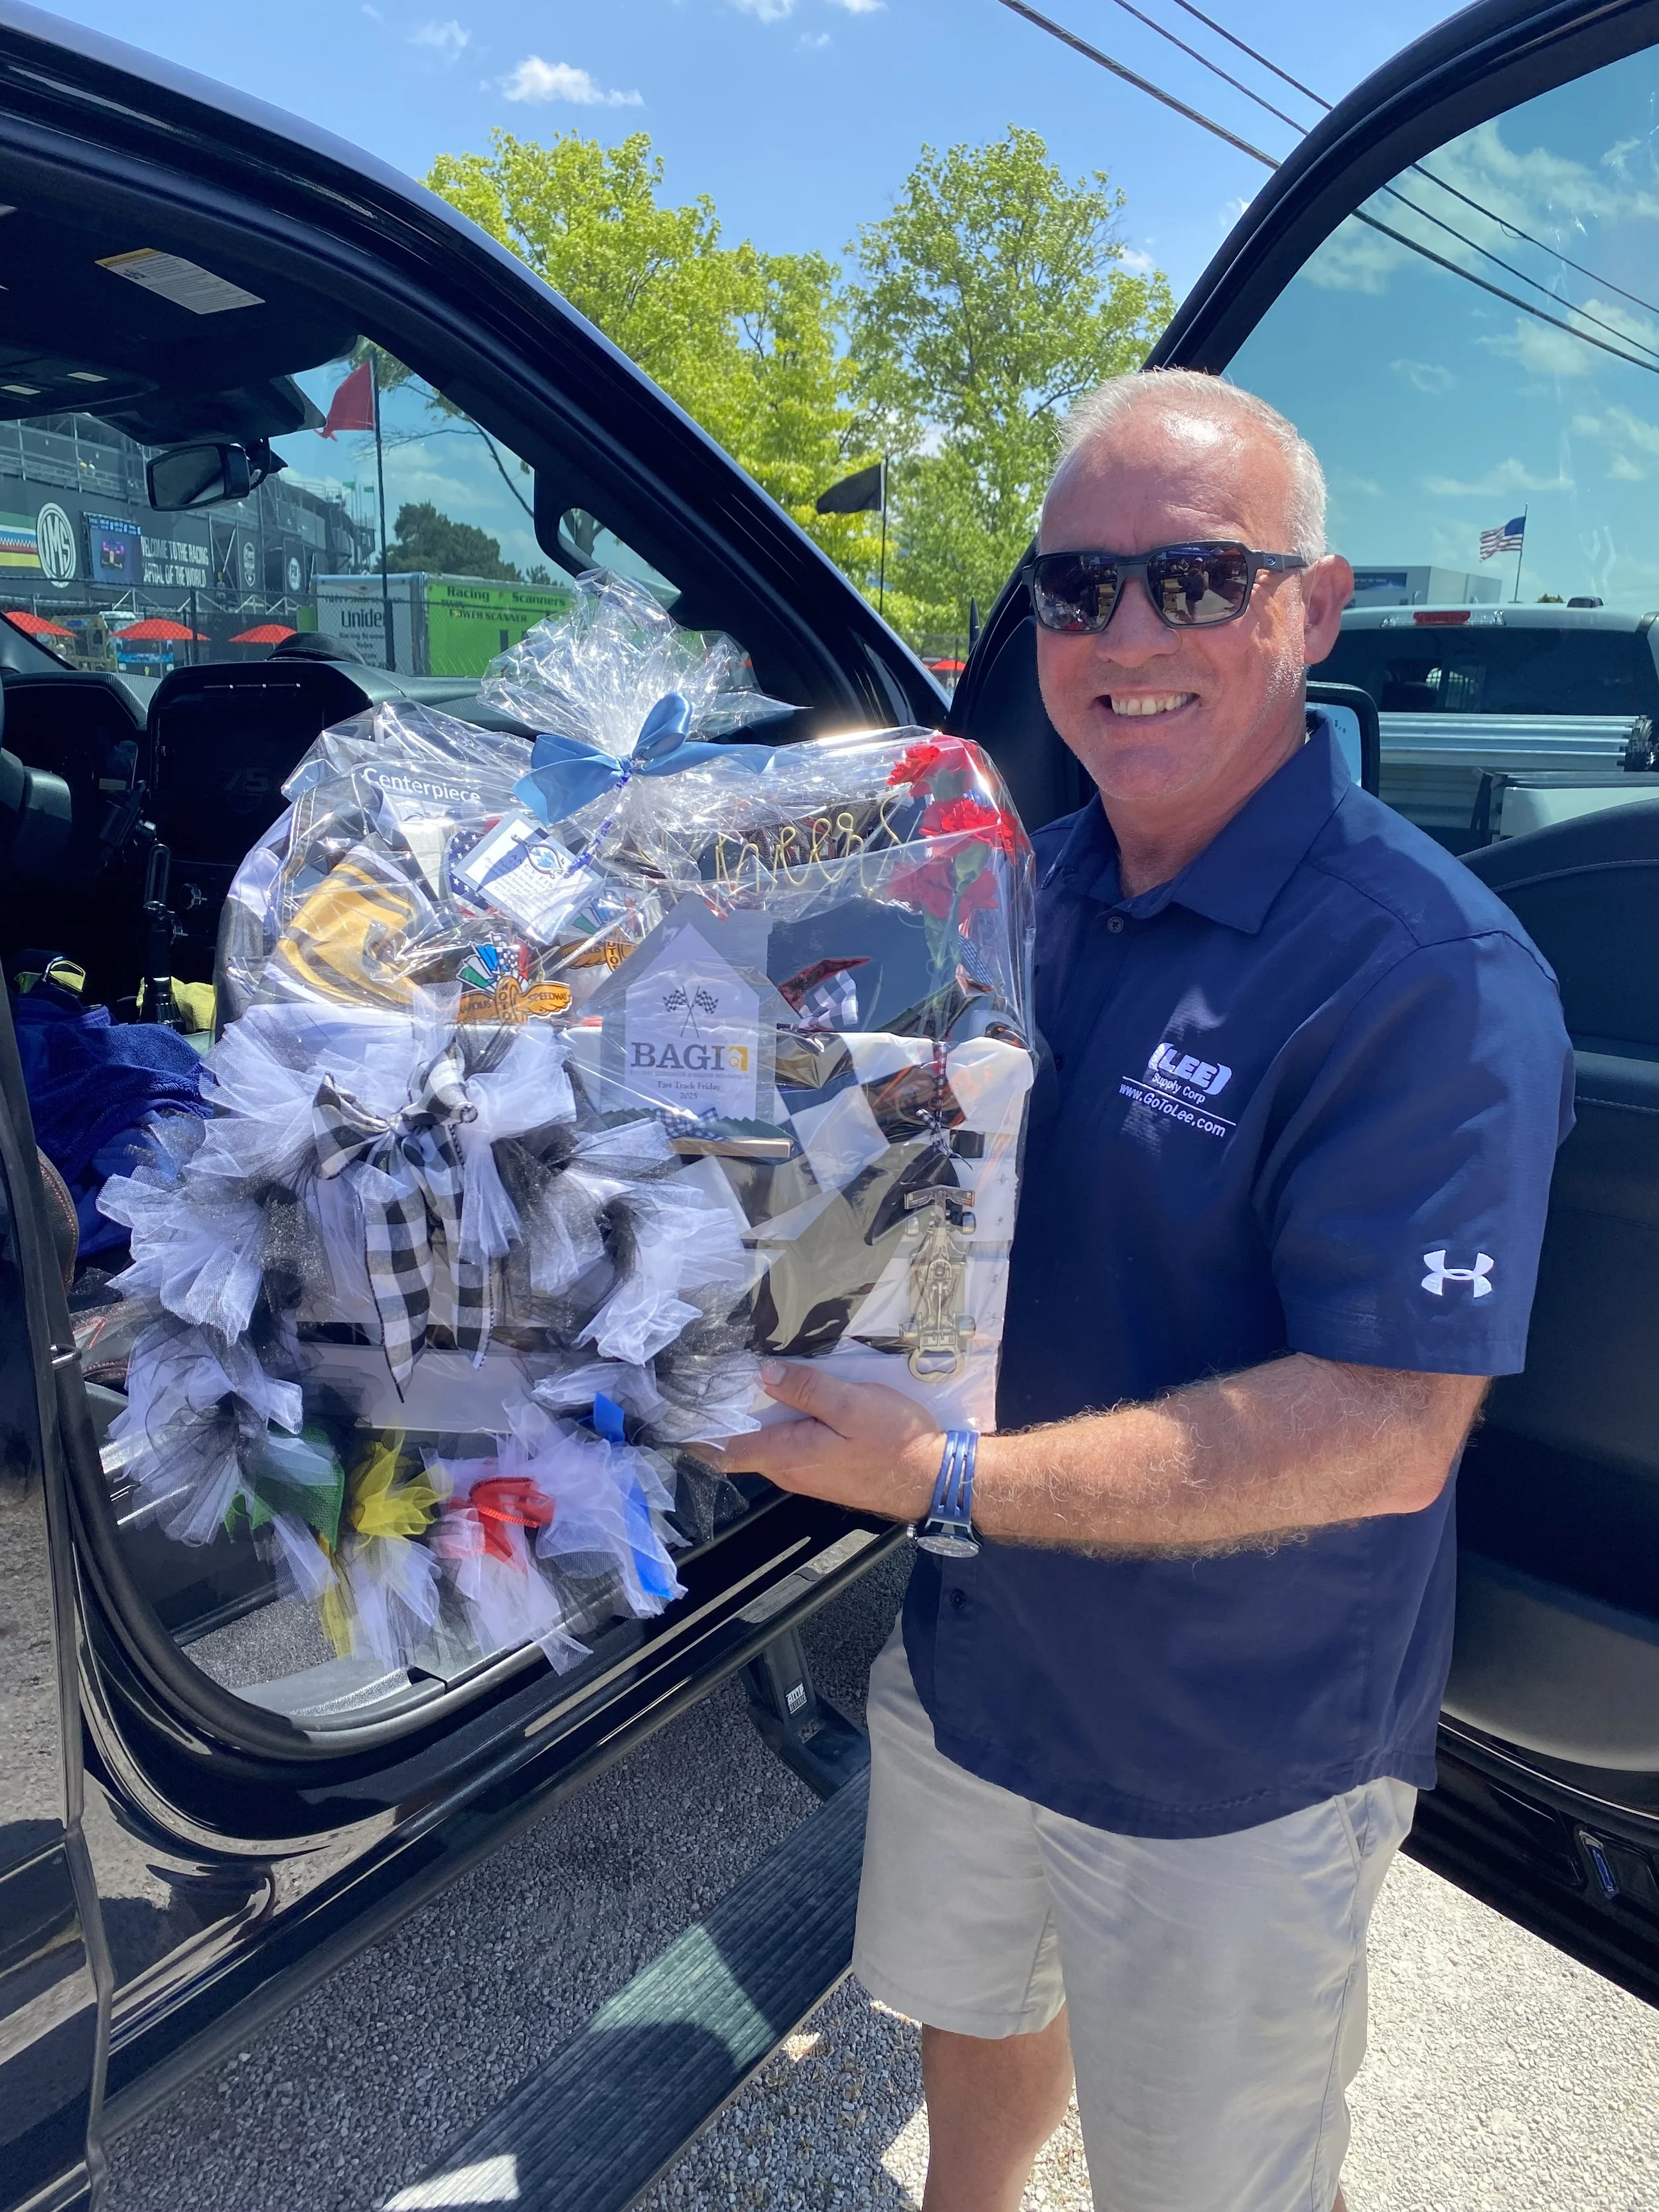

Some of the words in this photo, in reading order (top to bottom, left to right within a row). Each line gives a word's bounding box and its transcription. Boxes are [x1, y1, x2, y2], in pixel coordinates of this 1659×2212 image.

[42, 513, 70, 575] IMS
[168, 541, 178, 561] TO
[177, 542, 188, 562] THE
[188, 544, 209, 565] RACING
[143, 562, 165, 584] APITAL
[165, 564, 174, 584] OF
[174, 565, 186, 586] THE
[185, 566, 206, 589] WORLD
[447, 585, 490, 603] Racing
[512, 591, 565, 606] Scanners
[341, 609, 384, 628] Unide
[364, 767, 481, 802] Centerpiece
[630, 1042, 725, 1070] BAGI
[1158, 1048, 1218, 1088] LEE
[1152, 1072, 1182, 1094] Supply
[1183, 1086, 1206, 1104] Corp
[1119, 1084, 1226, 1138] www.GoToLee.com
